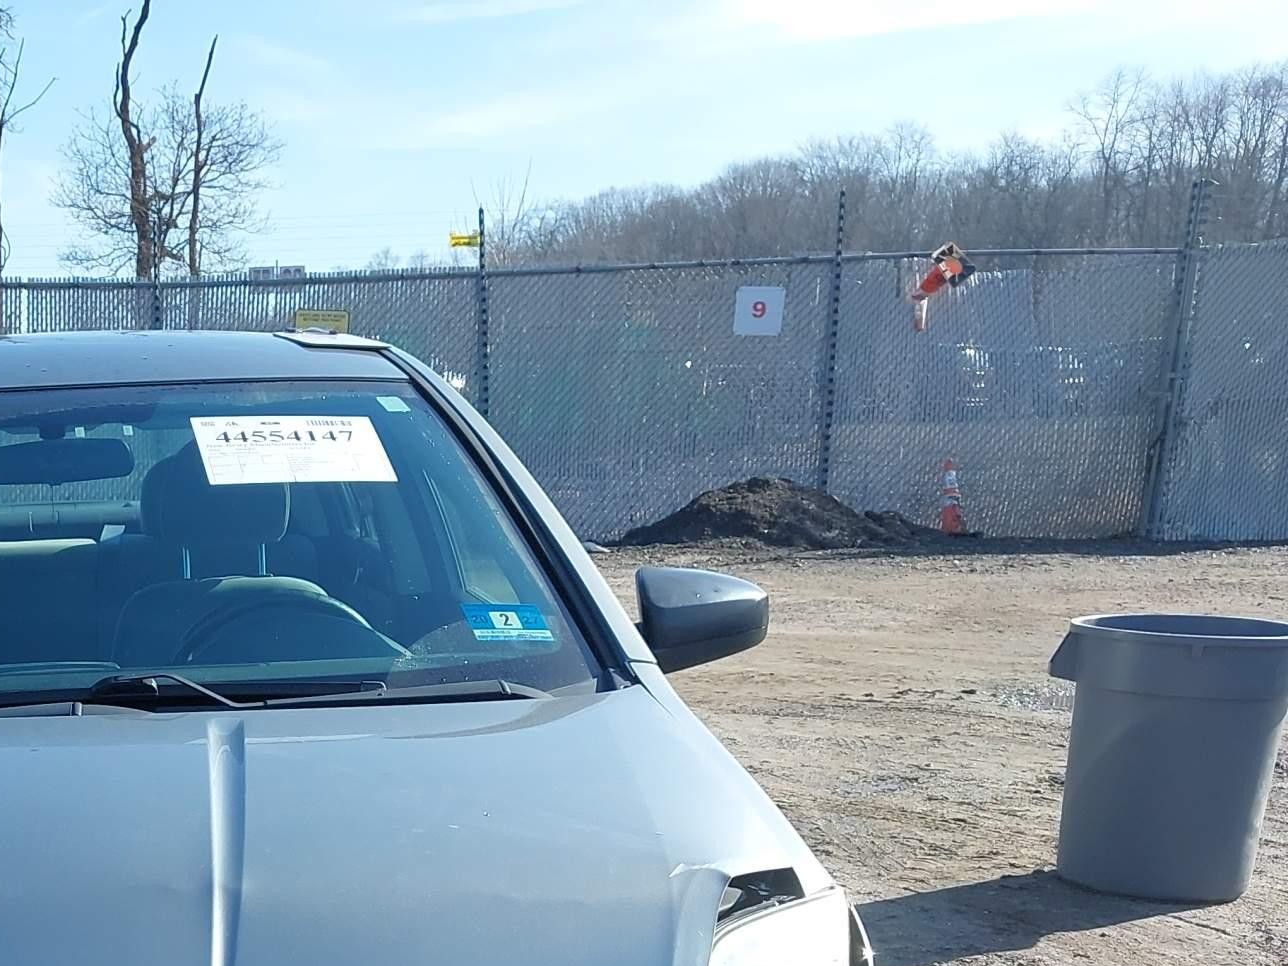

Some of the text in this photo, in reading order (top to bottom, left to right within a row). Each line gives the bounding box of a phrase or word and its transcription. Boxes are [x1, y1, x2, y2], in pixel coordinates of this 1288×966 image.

[752, 302, 767, 320] 9
[215, 430, 353, 443] 44554147
[499, 613, 514, 627] 2
